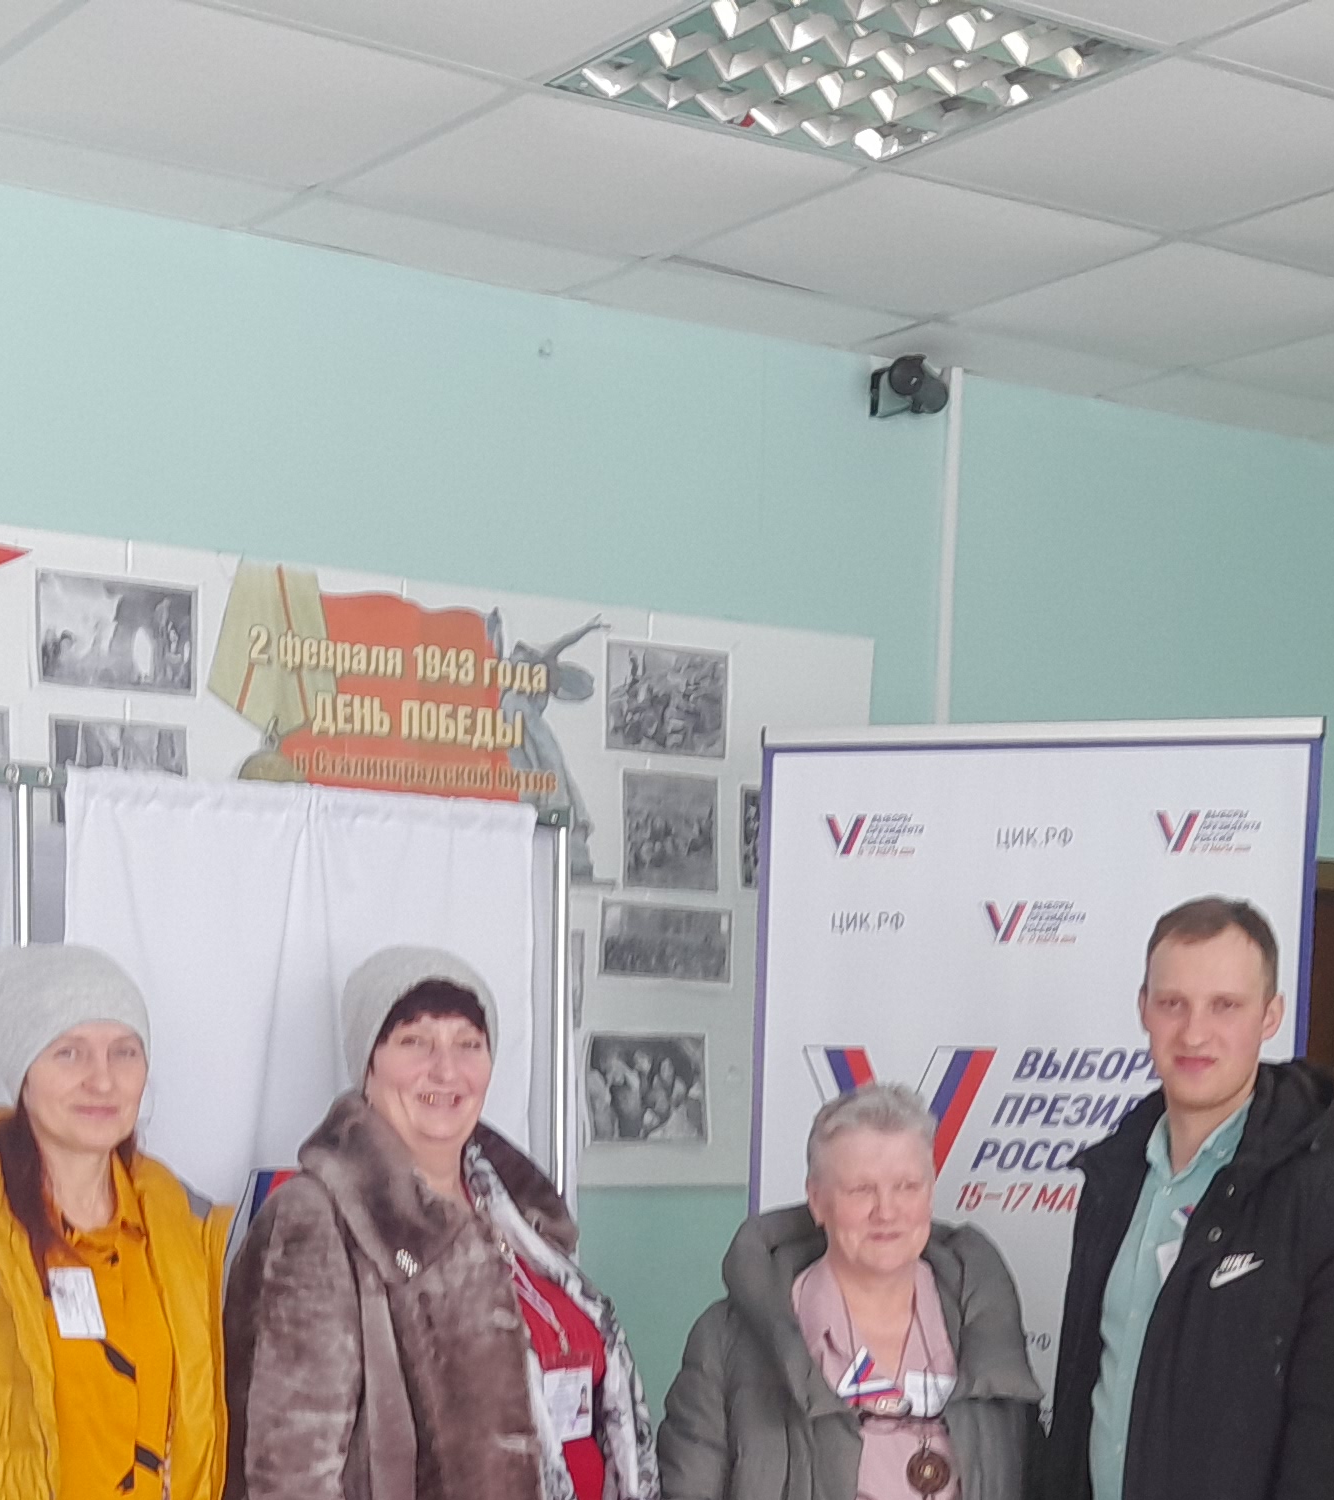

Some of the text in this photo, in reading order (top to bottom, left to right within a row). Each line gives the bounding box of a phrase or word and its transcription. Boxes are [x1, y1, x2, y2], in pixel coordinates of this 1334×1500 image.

[248, 624, 270, 663] 2
[278, 629, 404, 680] февраля
[482, 656, 548, 695] года
[311, 690, 523, 751] ДЕНЬ ПОБЕДЫ
[996, 826, 1074, 850] ЦИК.РФ
[831, 911, 905, 935] ЦИК.РФ
[970, 1137, 1087, 1172] РОСС
[1032, 1183, 1078, 1212] МА
